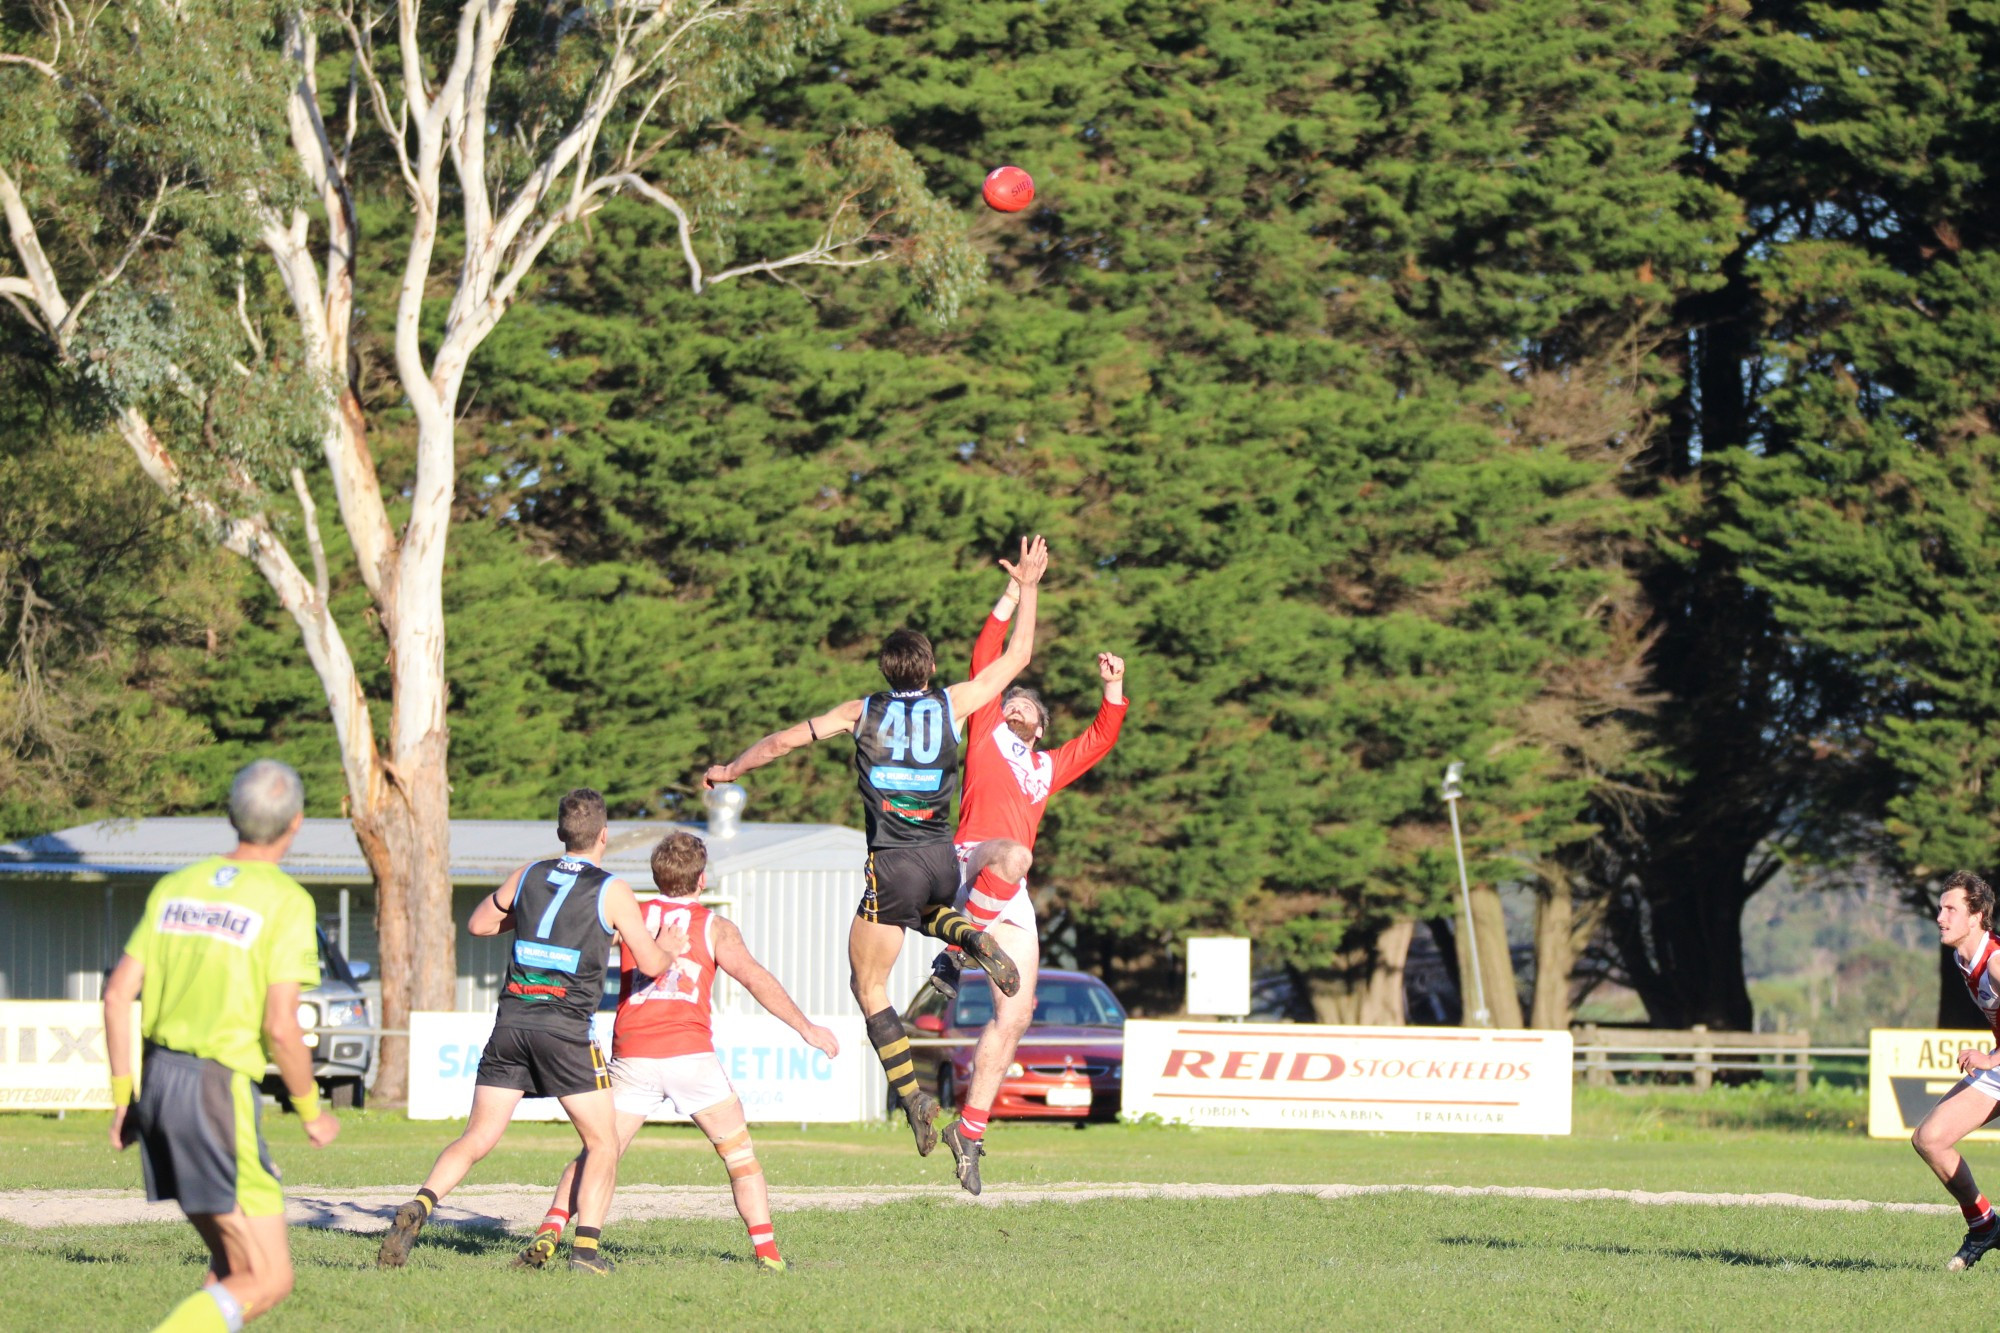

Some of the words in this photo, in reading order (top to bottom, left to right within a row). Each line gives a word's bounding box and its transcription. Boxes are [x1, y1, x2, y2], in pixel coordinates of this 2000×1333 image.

[877, 698, 943, 764] 40
[163, 903, 251, 935] Herald
[536, 869, 578, 939] 7
[1161, 1049, 1346, 1082] REID
[1350, 1059, 1532, 1081] STOCKFEEDS
[1189, 1106, 1250, 1117] COBDEN
